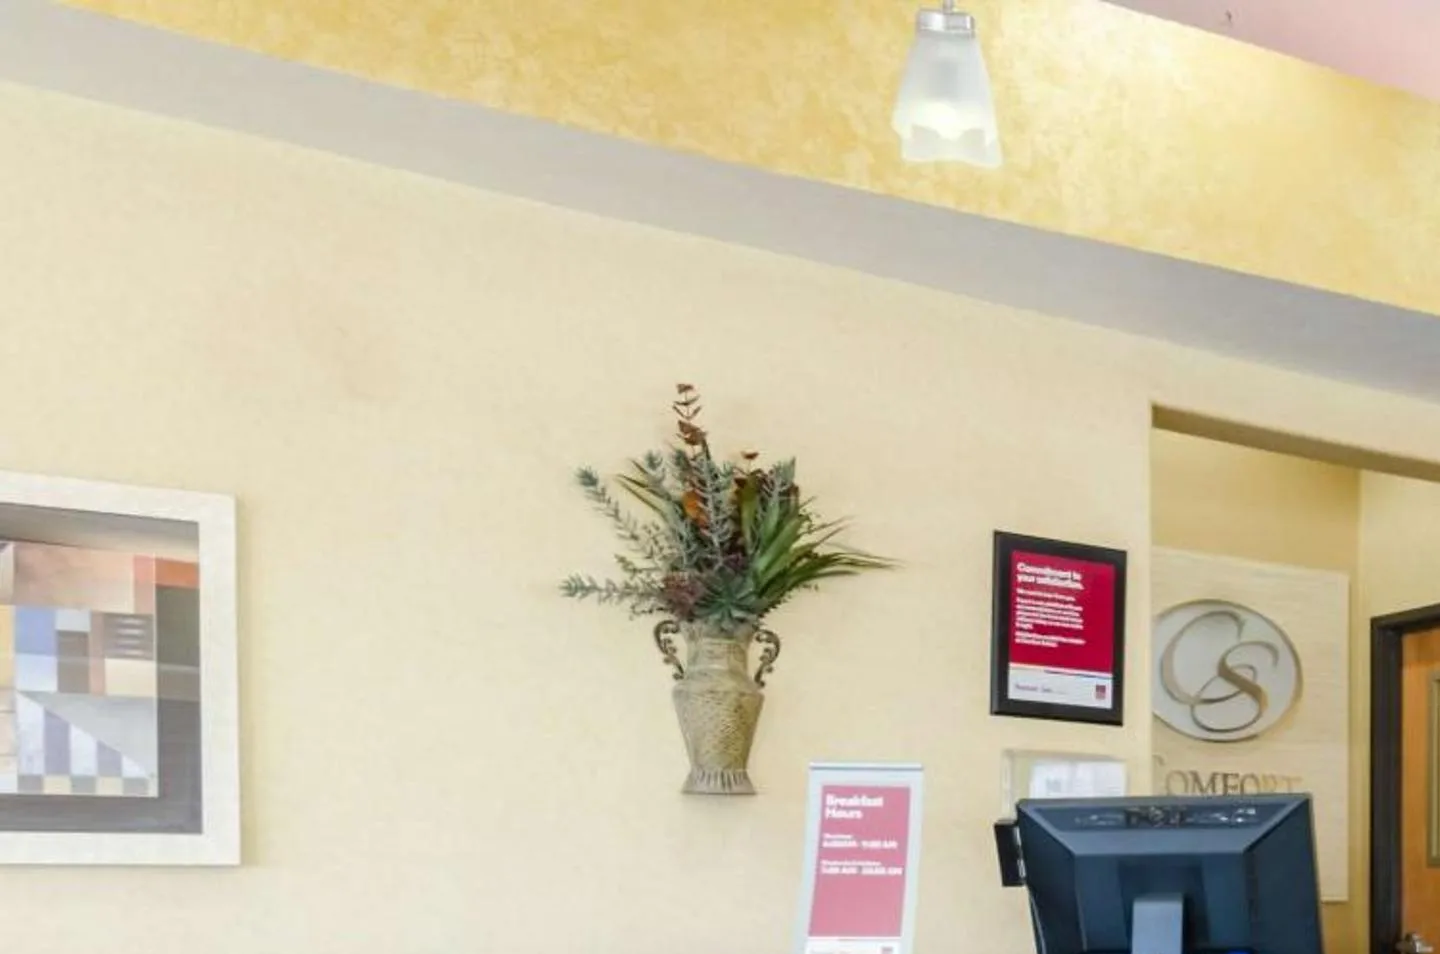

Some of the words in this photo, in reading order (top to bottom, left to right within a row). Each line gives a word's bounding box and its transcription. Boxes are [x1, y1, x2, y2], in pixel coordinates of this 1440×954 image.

[1152, 755, 1304, 796] OMFORT
[825, 793, 884, 808] Breakfast
[825, 806, 863, 819] Hours
